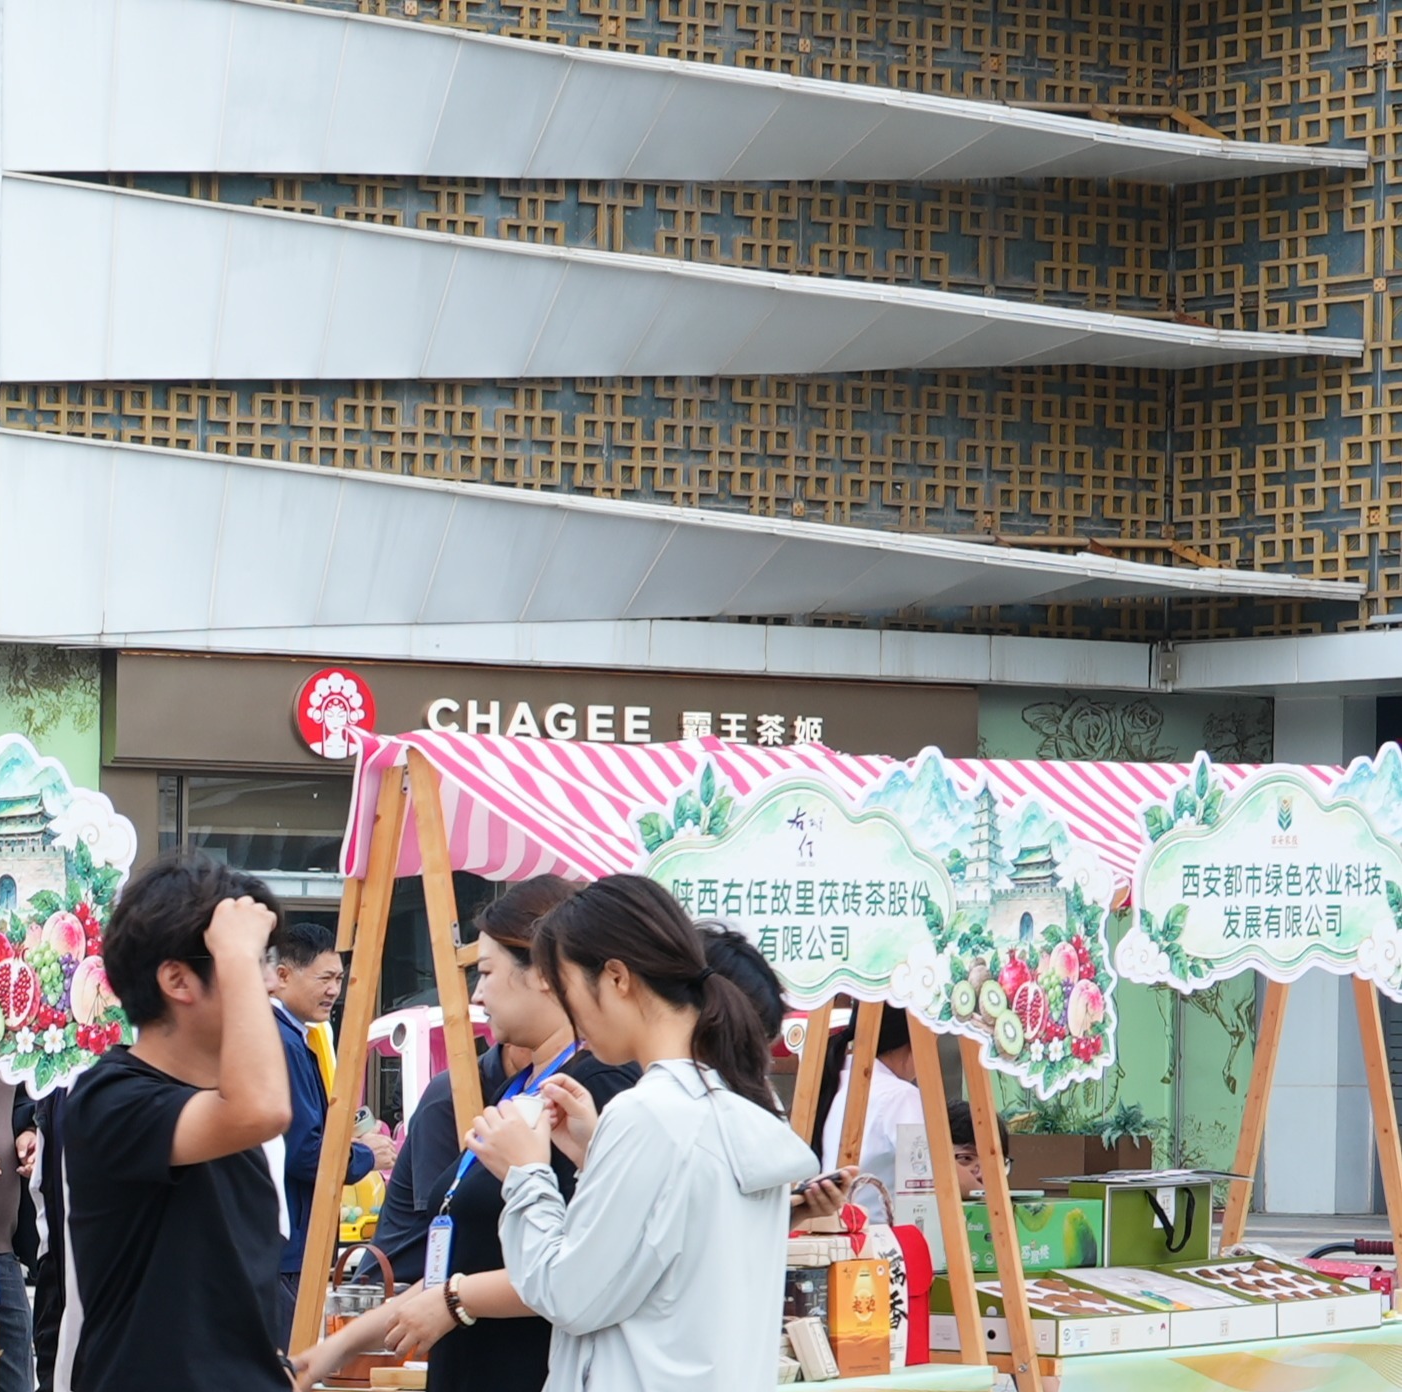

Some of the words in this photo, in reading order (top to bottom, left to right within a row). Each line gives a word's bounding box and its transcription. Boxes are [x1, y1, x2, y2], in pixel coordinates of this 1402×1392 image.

[427, 698, 652, 743] CHAGEE
[682, 711, 823, 745] 霸王茶姬
[673, 878, 931, 917] 陕西右任故里茯砖茶股份
[1182, 862, 1382, 899] 西安都市绿色农业科技
[1222, 904, 1342, 940] 发展有限公司
[757, 924, 851, 962] 有限公司
